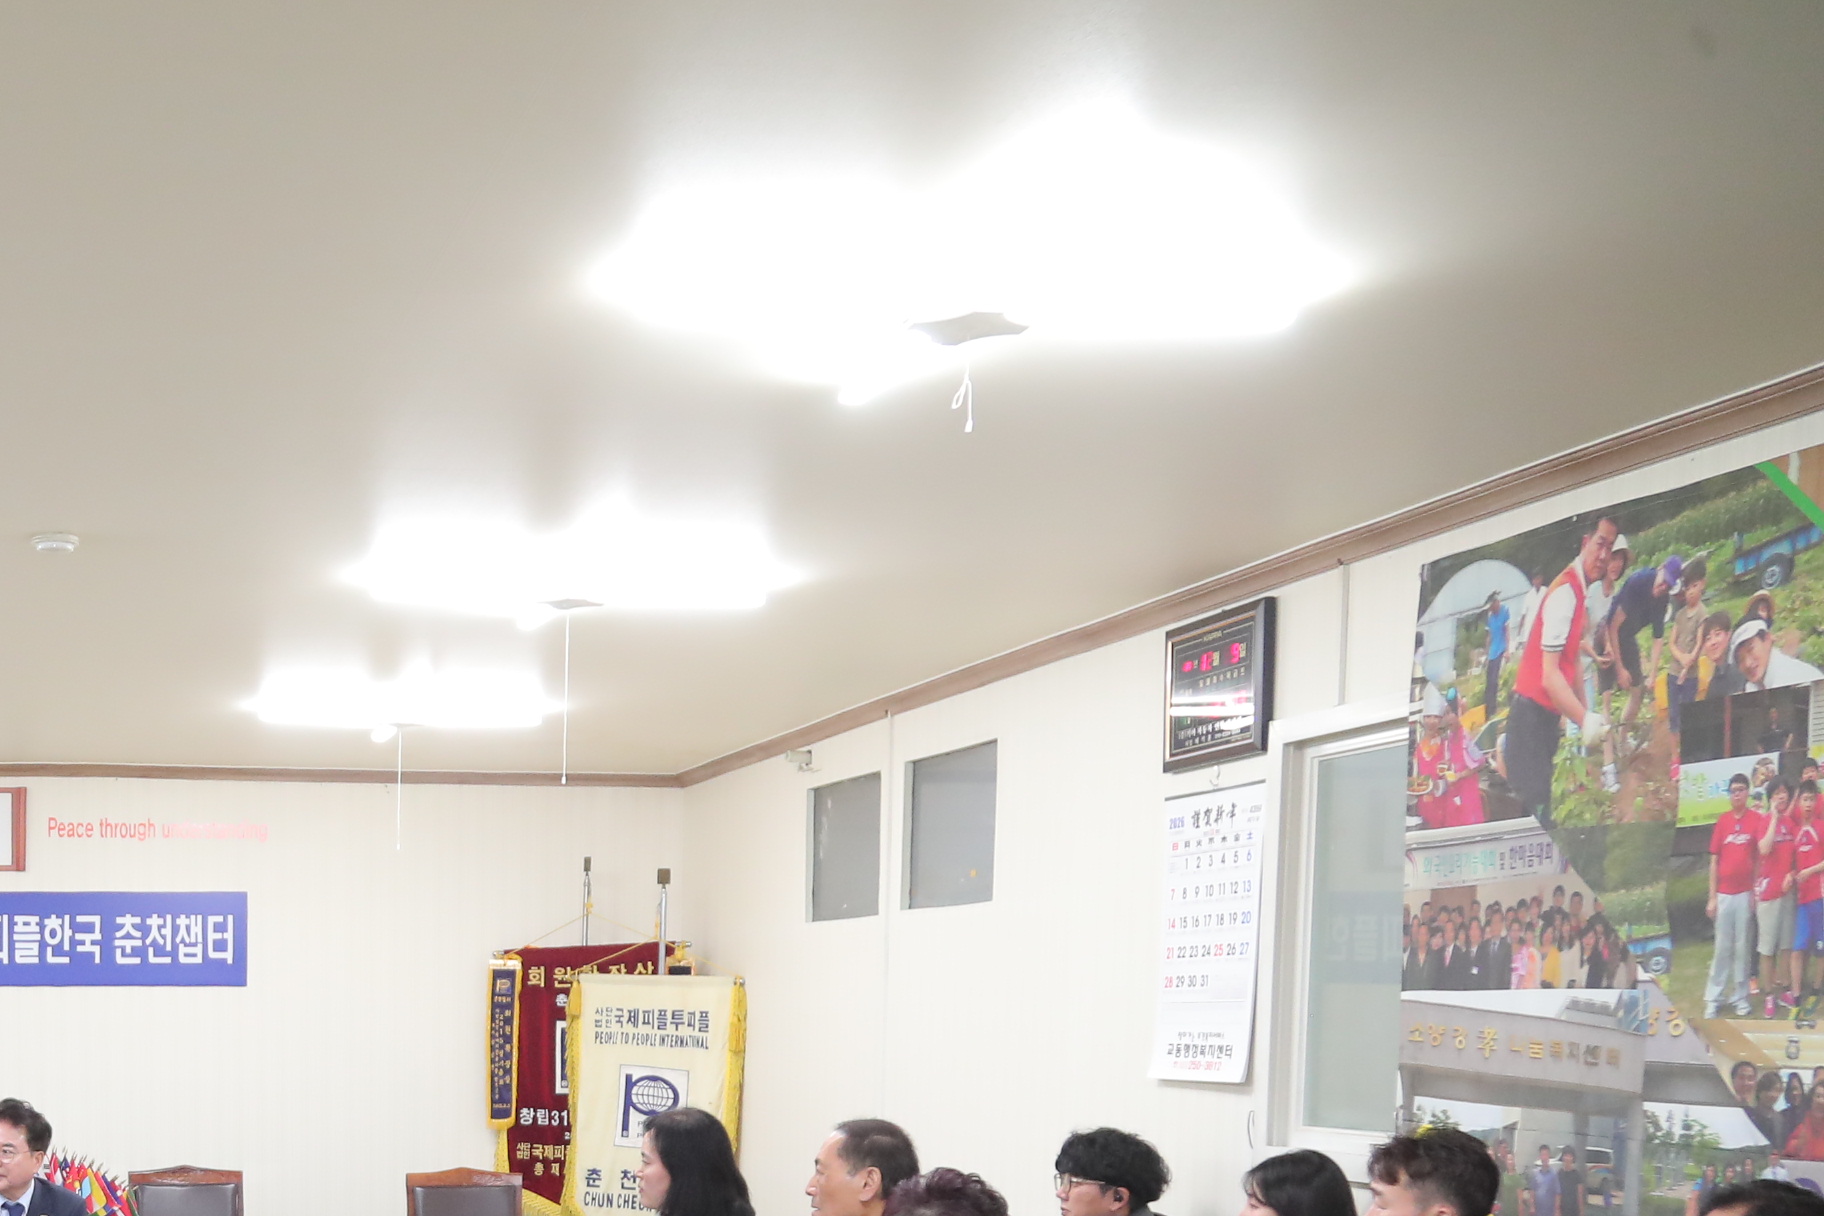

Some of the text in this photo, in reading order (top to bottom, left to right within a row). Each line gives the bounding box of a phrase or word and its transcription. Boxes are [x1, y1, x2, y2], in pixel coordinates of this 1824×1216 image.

[48, 817, 94, 838] Peace
[100, 818, 156, 841] through
[1185, 849, 1252, 870] 1 2 3 4 5 6
[1171, 879, 1252, 901] 7 8 9 10 11 12 13
[1167, 911, 1252, 930] 14 15 16 17 18 19 20
[114, 914, 235, 965] 춘천챕터
[1166, 942, 1250, 960] 21 22 23 24 25 26 27
[1164, 974, 1209, 989] 28 29 30 31
[615, 1007, 710, 1033] 국제피플투피플
[620, 1032, 630, 1045] TO
[631, 1031, 657, 1047] PEOPLE
[659, 1033, 710, 1050] INTERNATIONAL
[1408, 1022, 1468, 1050] 소양강
[1478, 1026, 1498, 1058] 孝
[1167, 1043, 1233, 1059] 교동행정복지센터
[519, 1108, 569, 1126] 창립31
[584, 1191, 652, 1212] CHUN CHE
